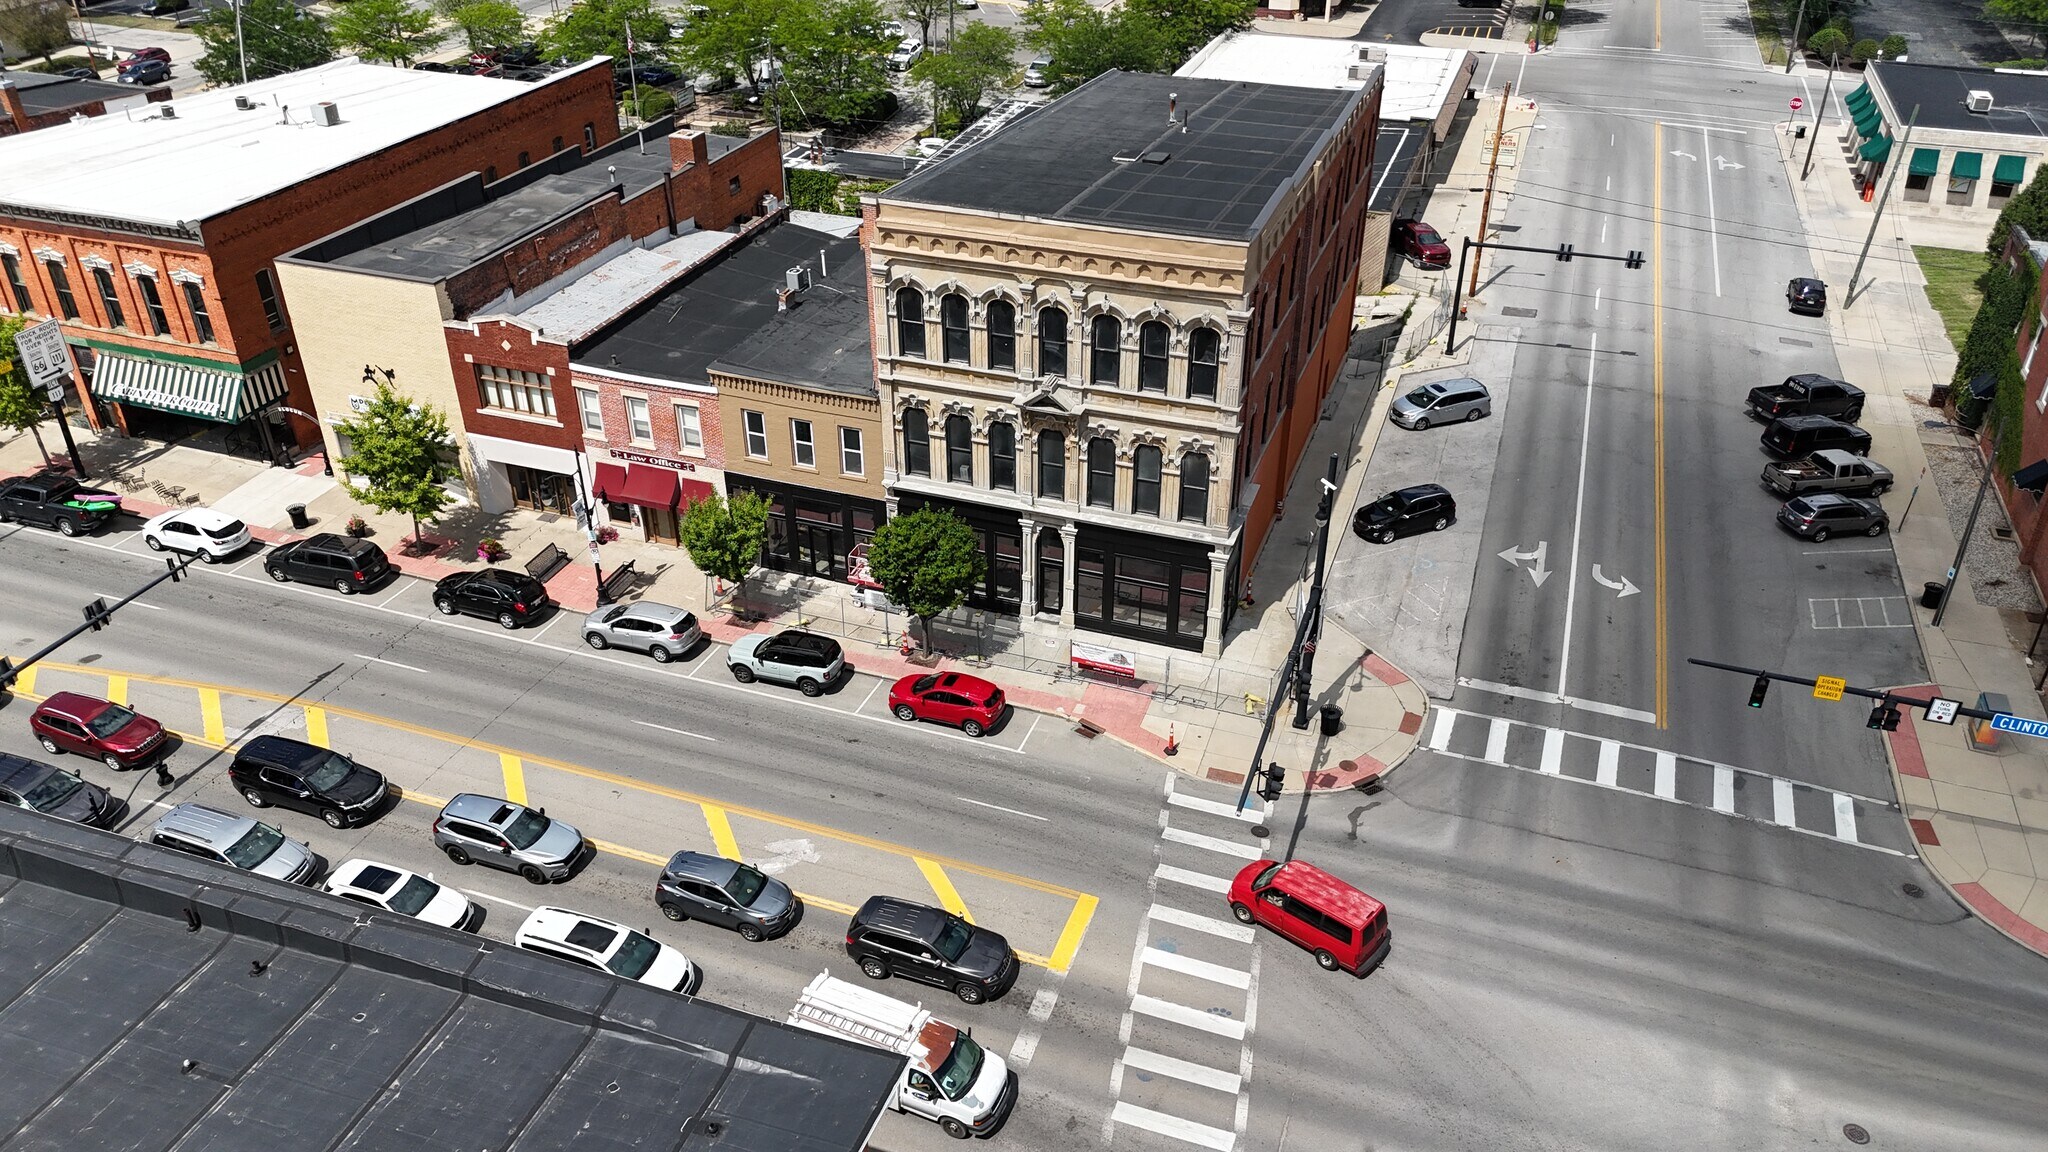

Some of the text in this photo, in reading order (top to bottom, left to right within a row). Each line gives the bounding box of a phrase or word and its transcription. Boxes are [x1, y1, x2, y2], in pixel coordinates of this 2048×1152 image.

[17, 321, 57, 340] TRUCK ROUTE
[20, 328, 58, 347] FOR HEIGHTS
[26, 340, 42, 351] OVER
[52, 353, 62, 363] 111
[34, 362, 45, 371] 66
[51, 390, 62, 399] 111
[111, 384, 144, 399] CABIN
[623, 453, 682, 469] Law Office
[1821, 678, 1840, 686] SIGNAL
[1817, 684, 1842, 692] OPERATION
[1818, 690, 1838, 698] CHANGED
[2000, 717, 2048, 736] CLINTO
